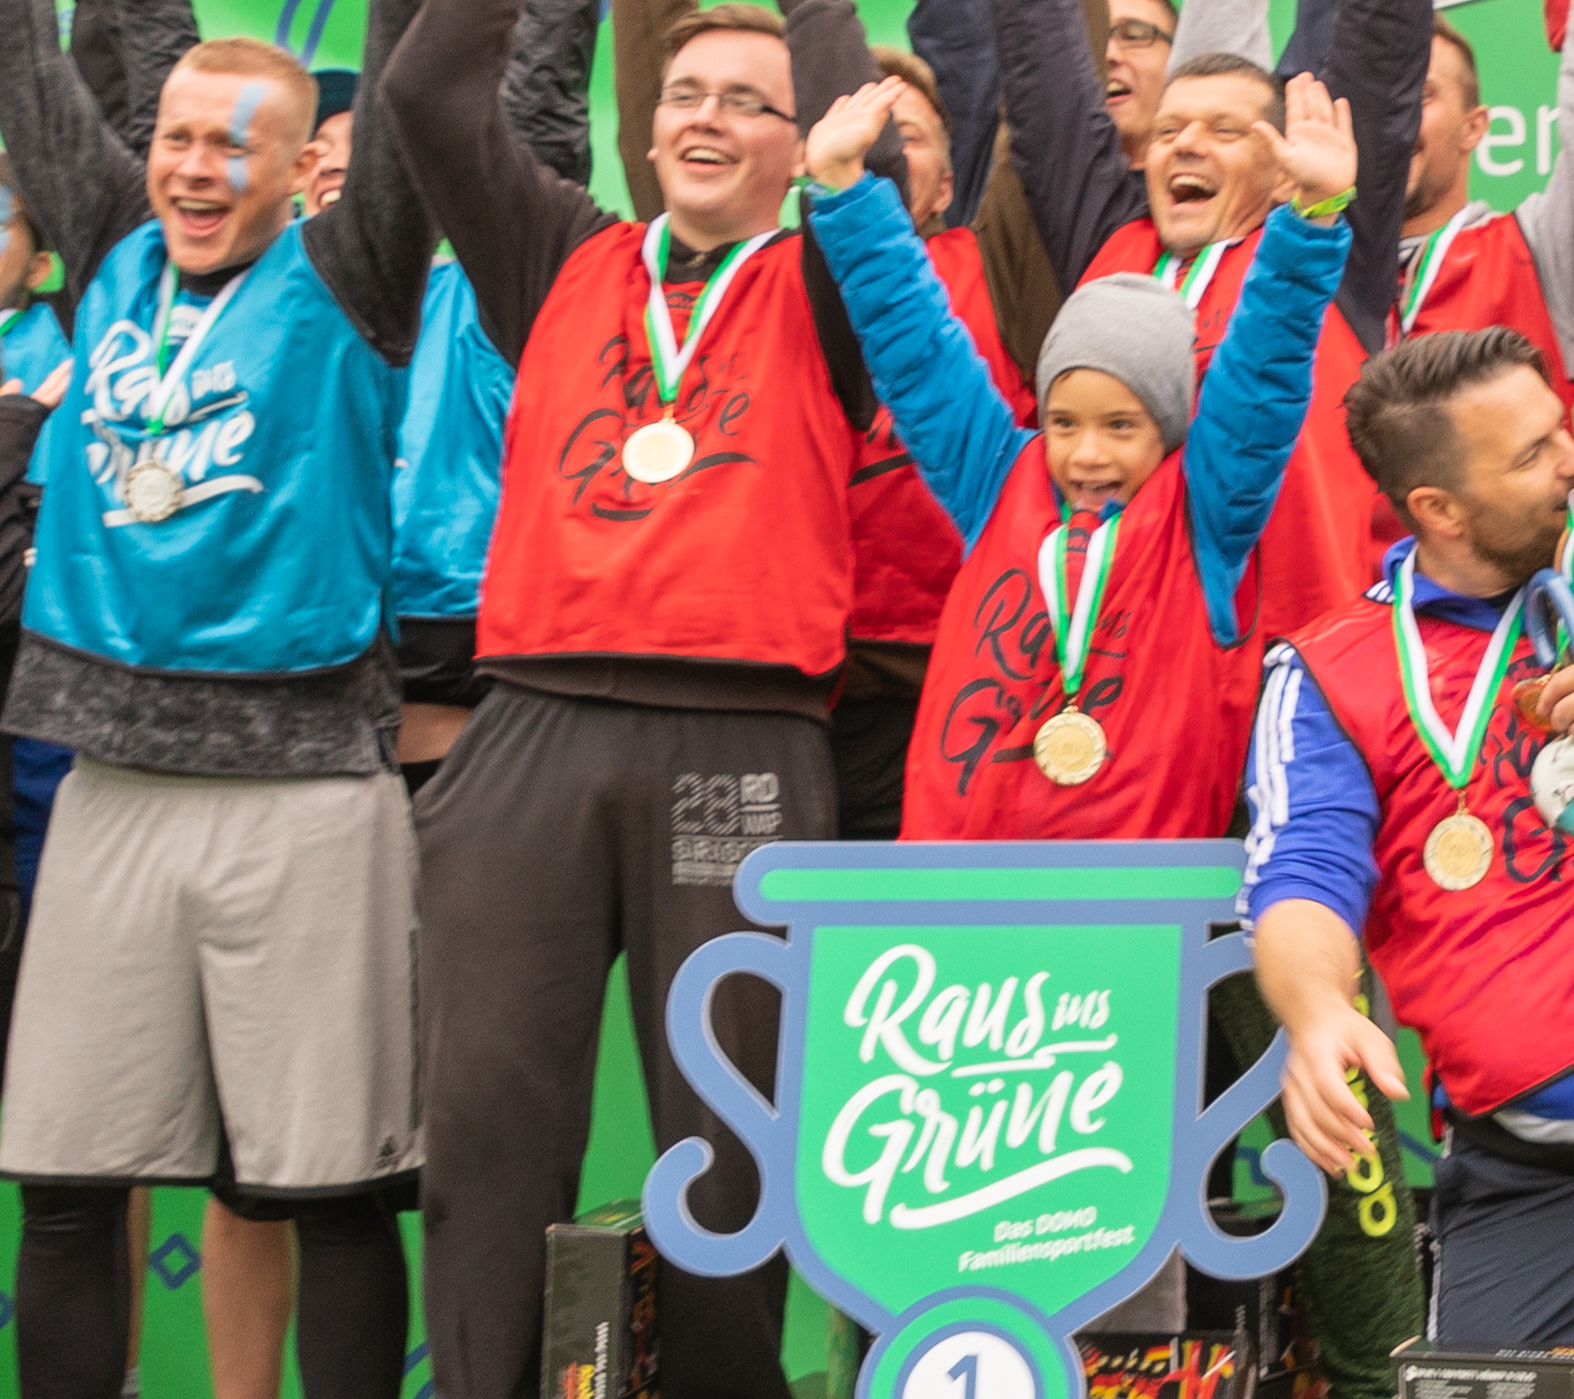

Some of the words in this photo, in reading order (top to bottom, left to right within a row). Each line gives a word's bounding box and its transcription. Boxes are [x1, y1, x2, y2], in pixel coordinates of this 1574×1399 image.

[842, 942, 1051, 1076] Raus
[1051, 988, 1112, 1032] ins
[821, 1059, 1124, 1225] Grüne
[957, 1223, 1137, 1274] Familiensportfest
[993, 1218, 1034, 1243] Das
[1034, 1204, 1098, 1236] DOMO
